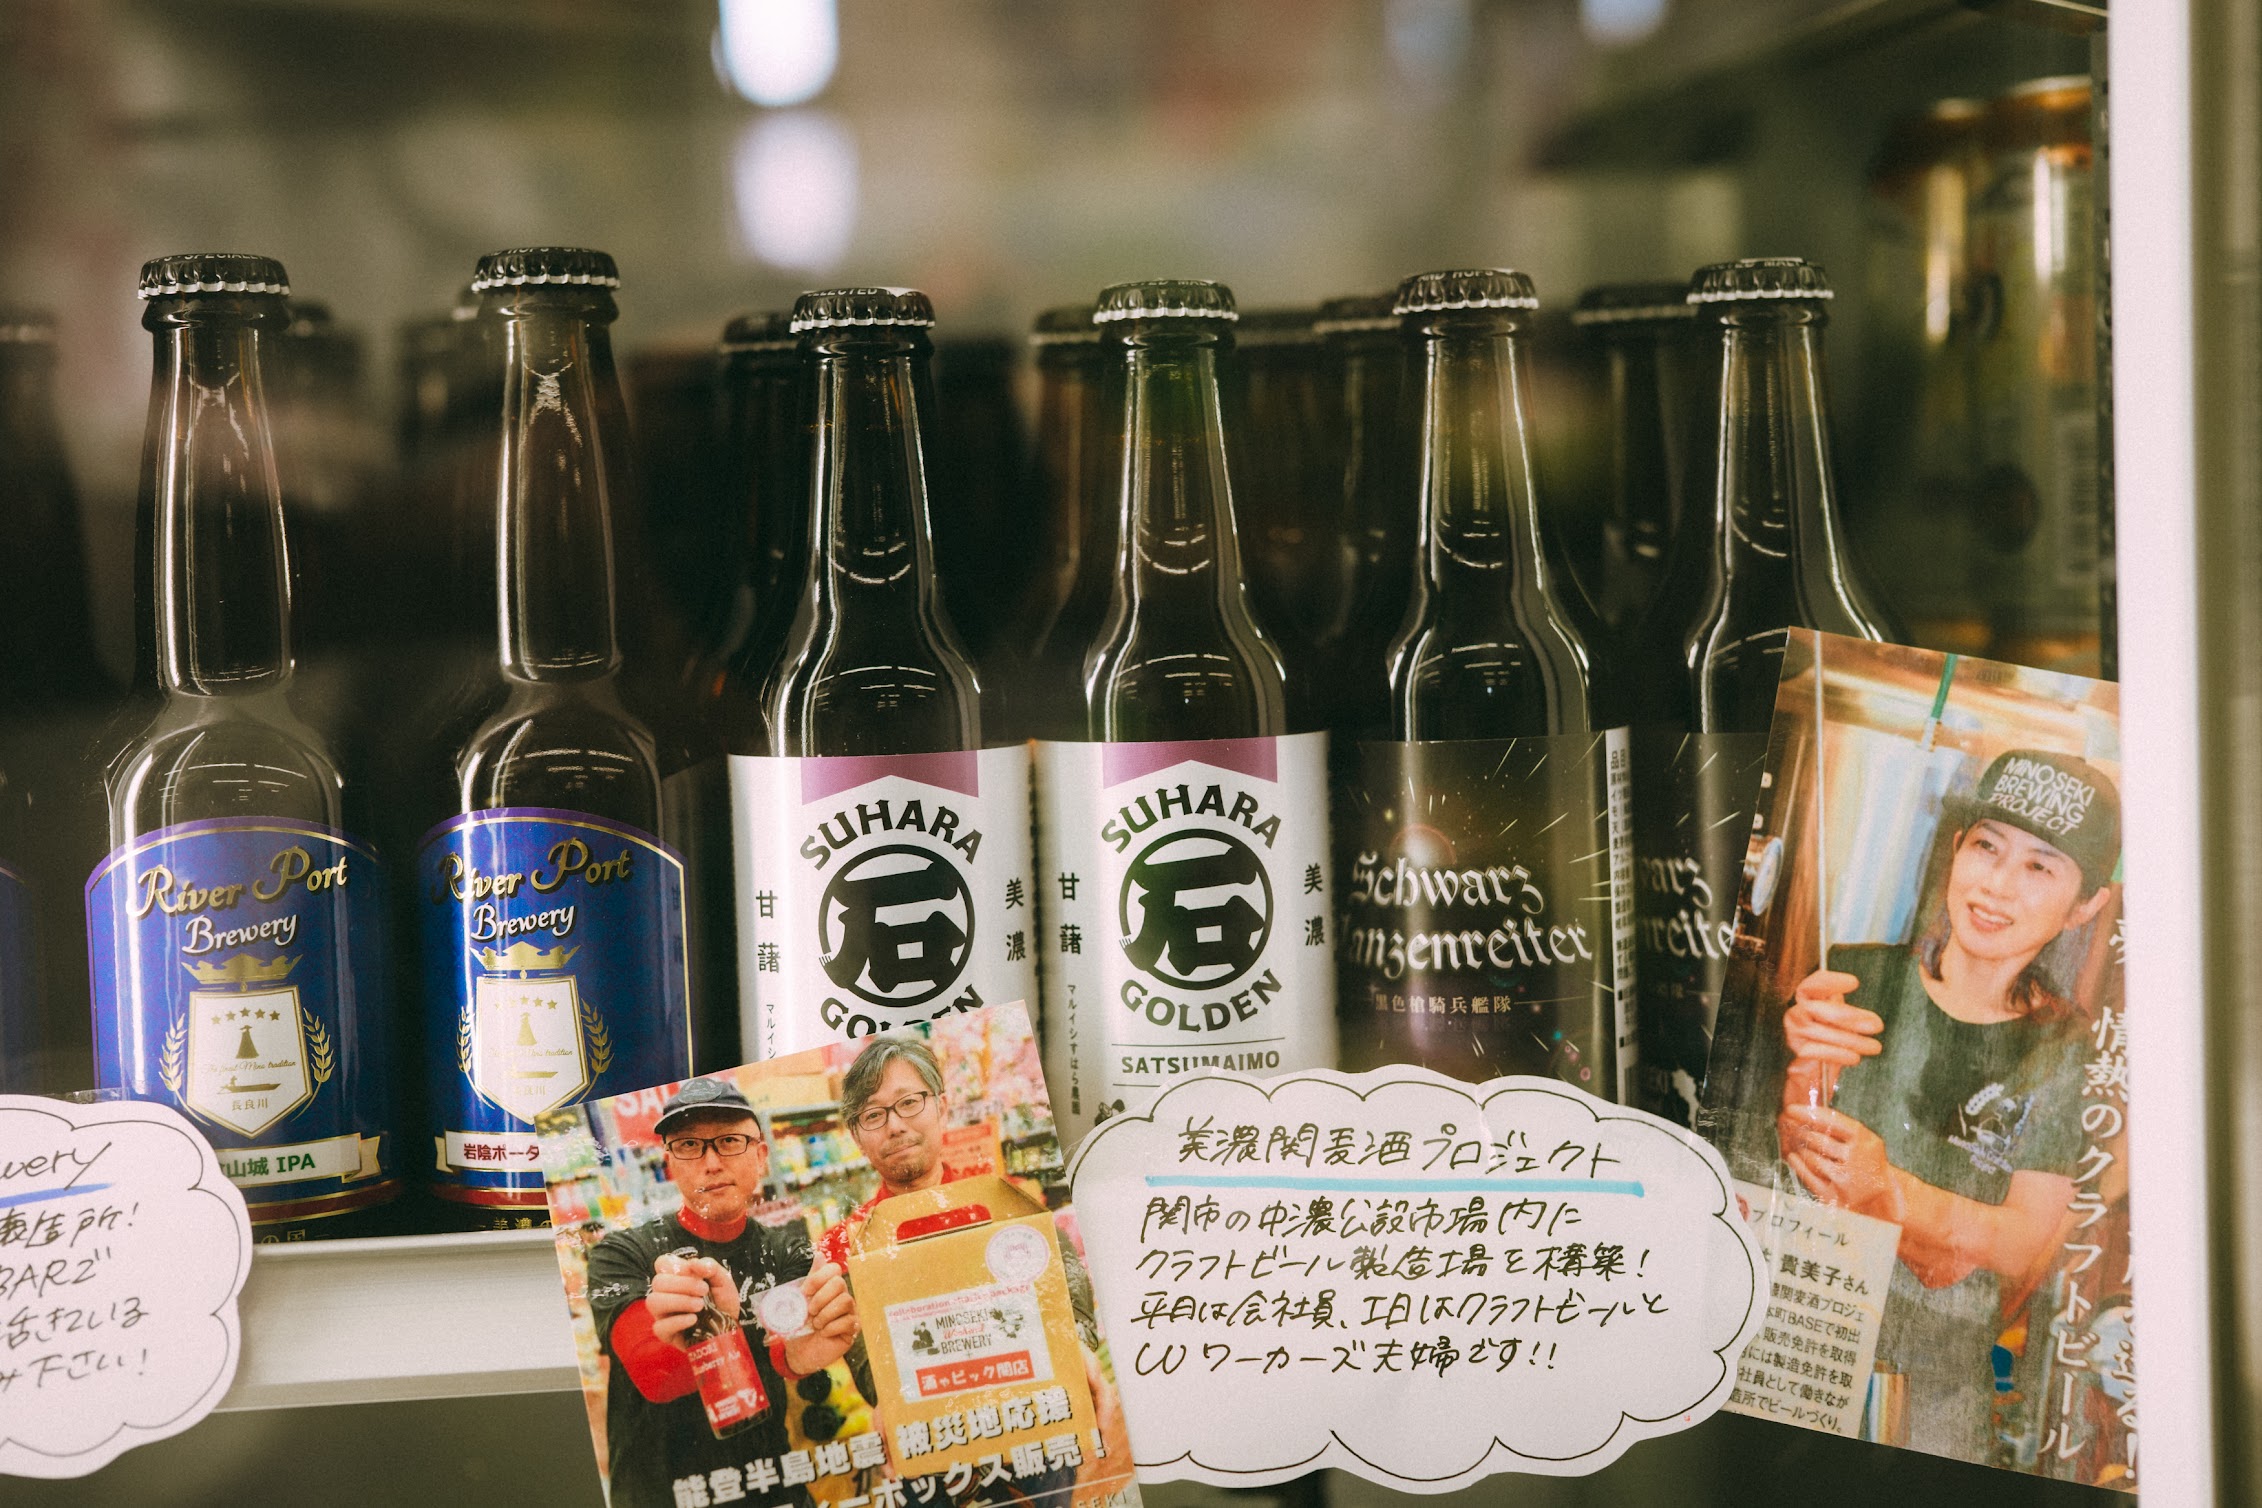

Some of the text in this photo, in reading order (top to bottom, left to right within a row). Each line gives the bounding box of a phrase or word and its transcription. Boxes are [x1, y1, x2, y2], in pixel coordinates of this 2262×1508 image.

[1994, 774, 2086, 824] BREWING
[2003, 757, 2096, 807] MINOSEKI
[800, 800, 982, 870] SUHARA
[1101, 784, 1282, 853] SUHARA
[1988, 792, 2080, 836] PROJECT
[126, 846, 347, 917] River Port
[430, 837, 631, 901] River Port
[1349, 850, 1545, 915] Schwarz
[470, 902, 575, 941] Brewery
[1005, 877, 1027, 962] 美濃
[1304, 862, 1326, 947] 美濃
[181, 914, 298, 954] Brewery
[819, 984, 985, 1040] GON
[1120, 968, 1283, 1033] GOLDEN
[219, 1153, 316, 1179] 山城 IPA
[1141, 1194, 1582, 1243] 関市の中濃公設市場内に
[1753, 1209, 1849, 1247] プロフィール
[1740, 1349, 1854, 1389] には製造免許を取
[771, 1428, 1106, 1508] ーボックス販売!
